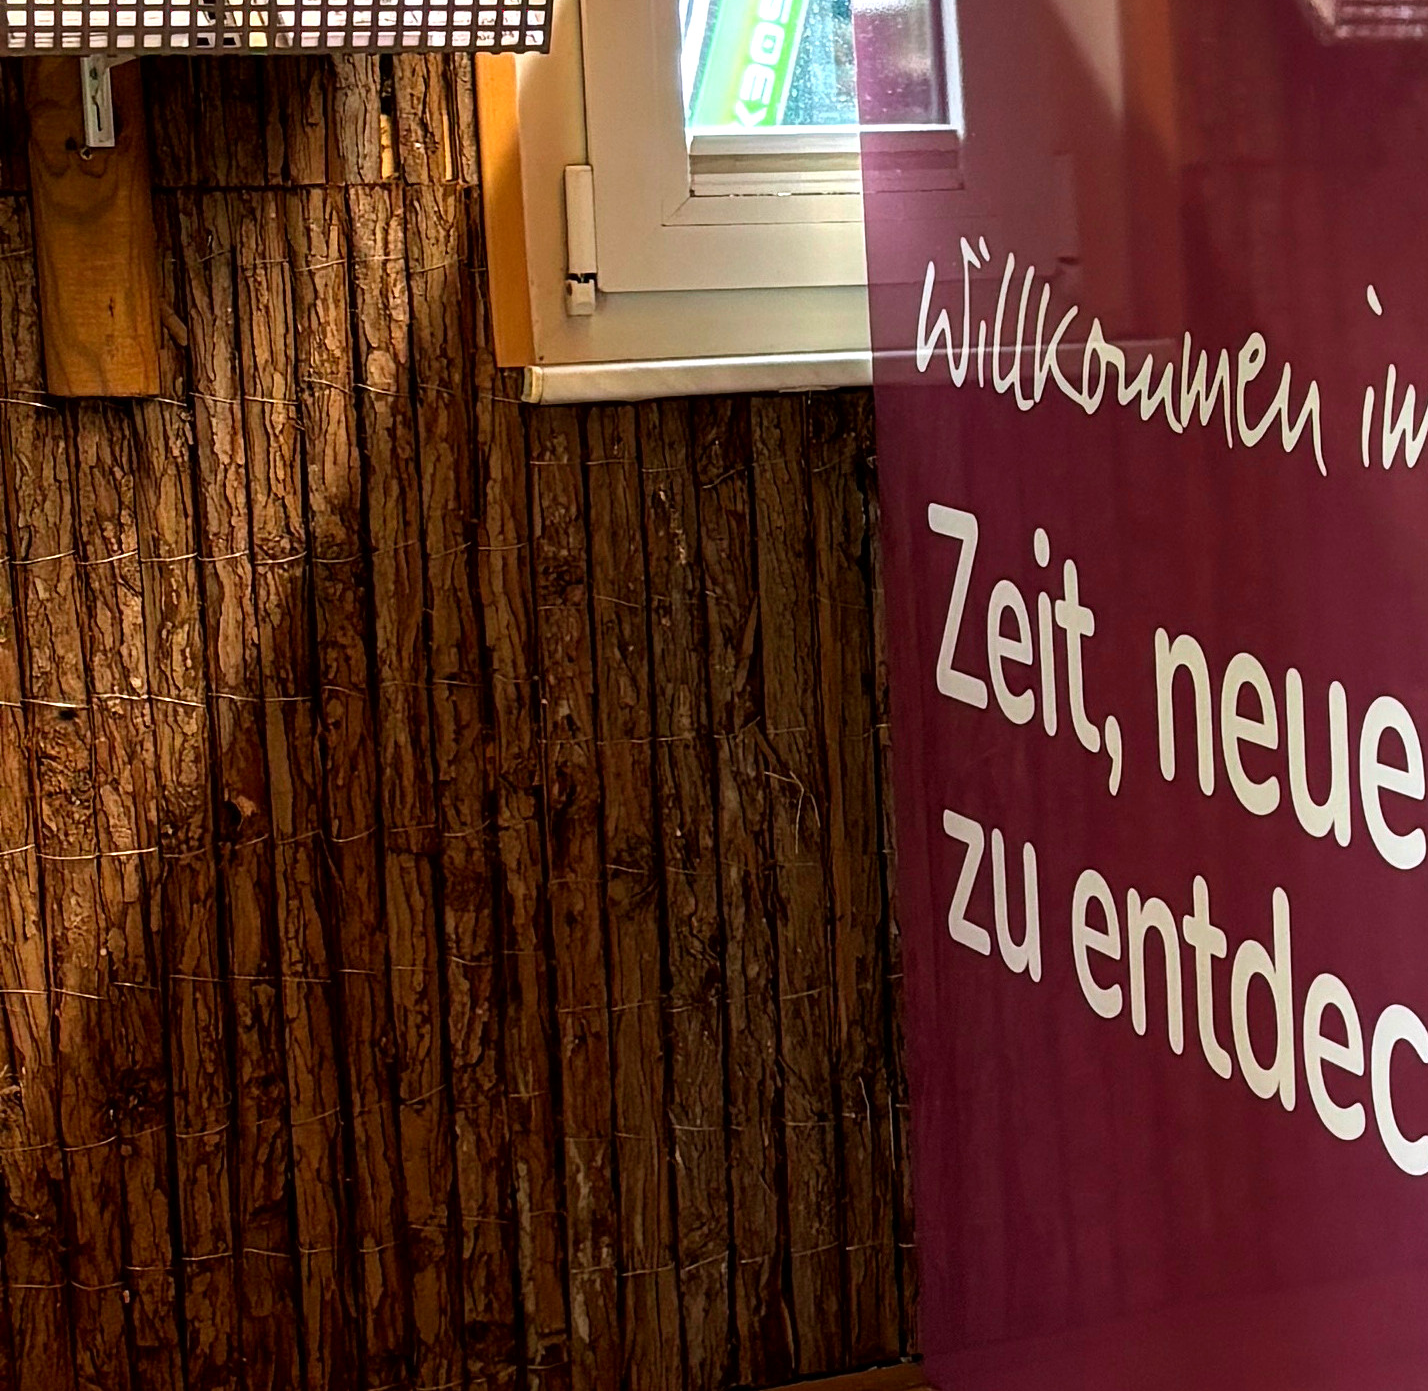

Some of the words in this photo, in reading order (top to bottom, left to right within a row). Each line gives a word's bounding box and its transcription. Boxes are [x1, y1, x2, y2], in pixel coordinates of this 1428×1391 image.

[915, 235, 1327, 477] Willkommen
[928, 504, 1122, 795] Zeit,
[1155, 627, 1427, 871] neue
[943, 808, 1042, 983] zu
